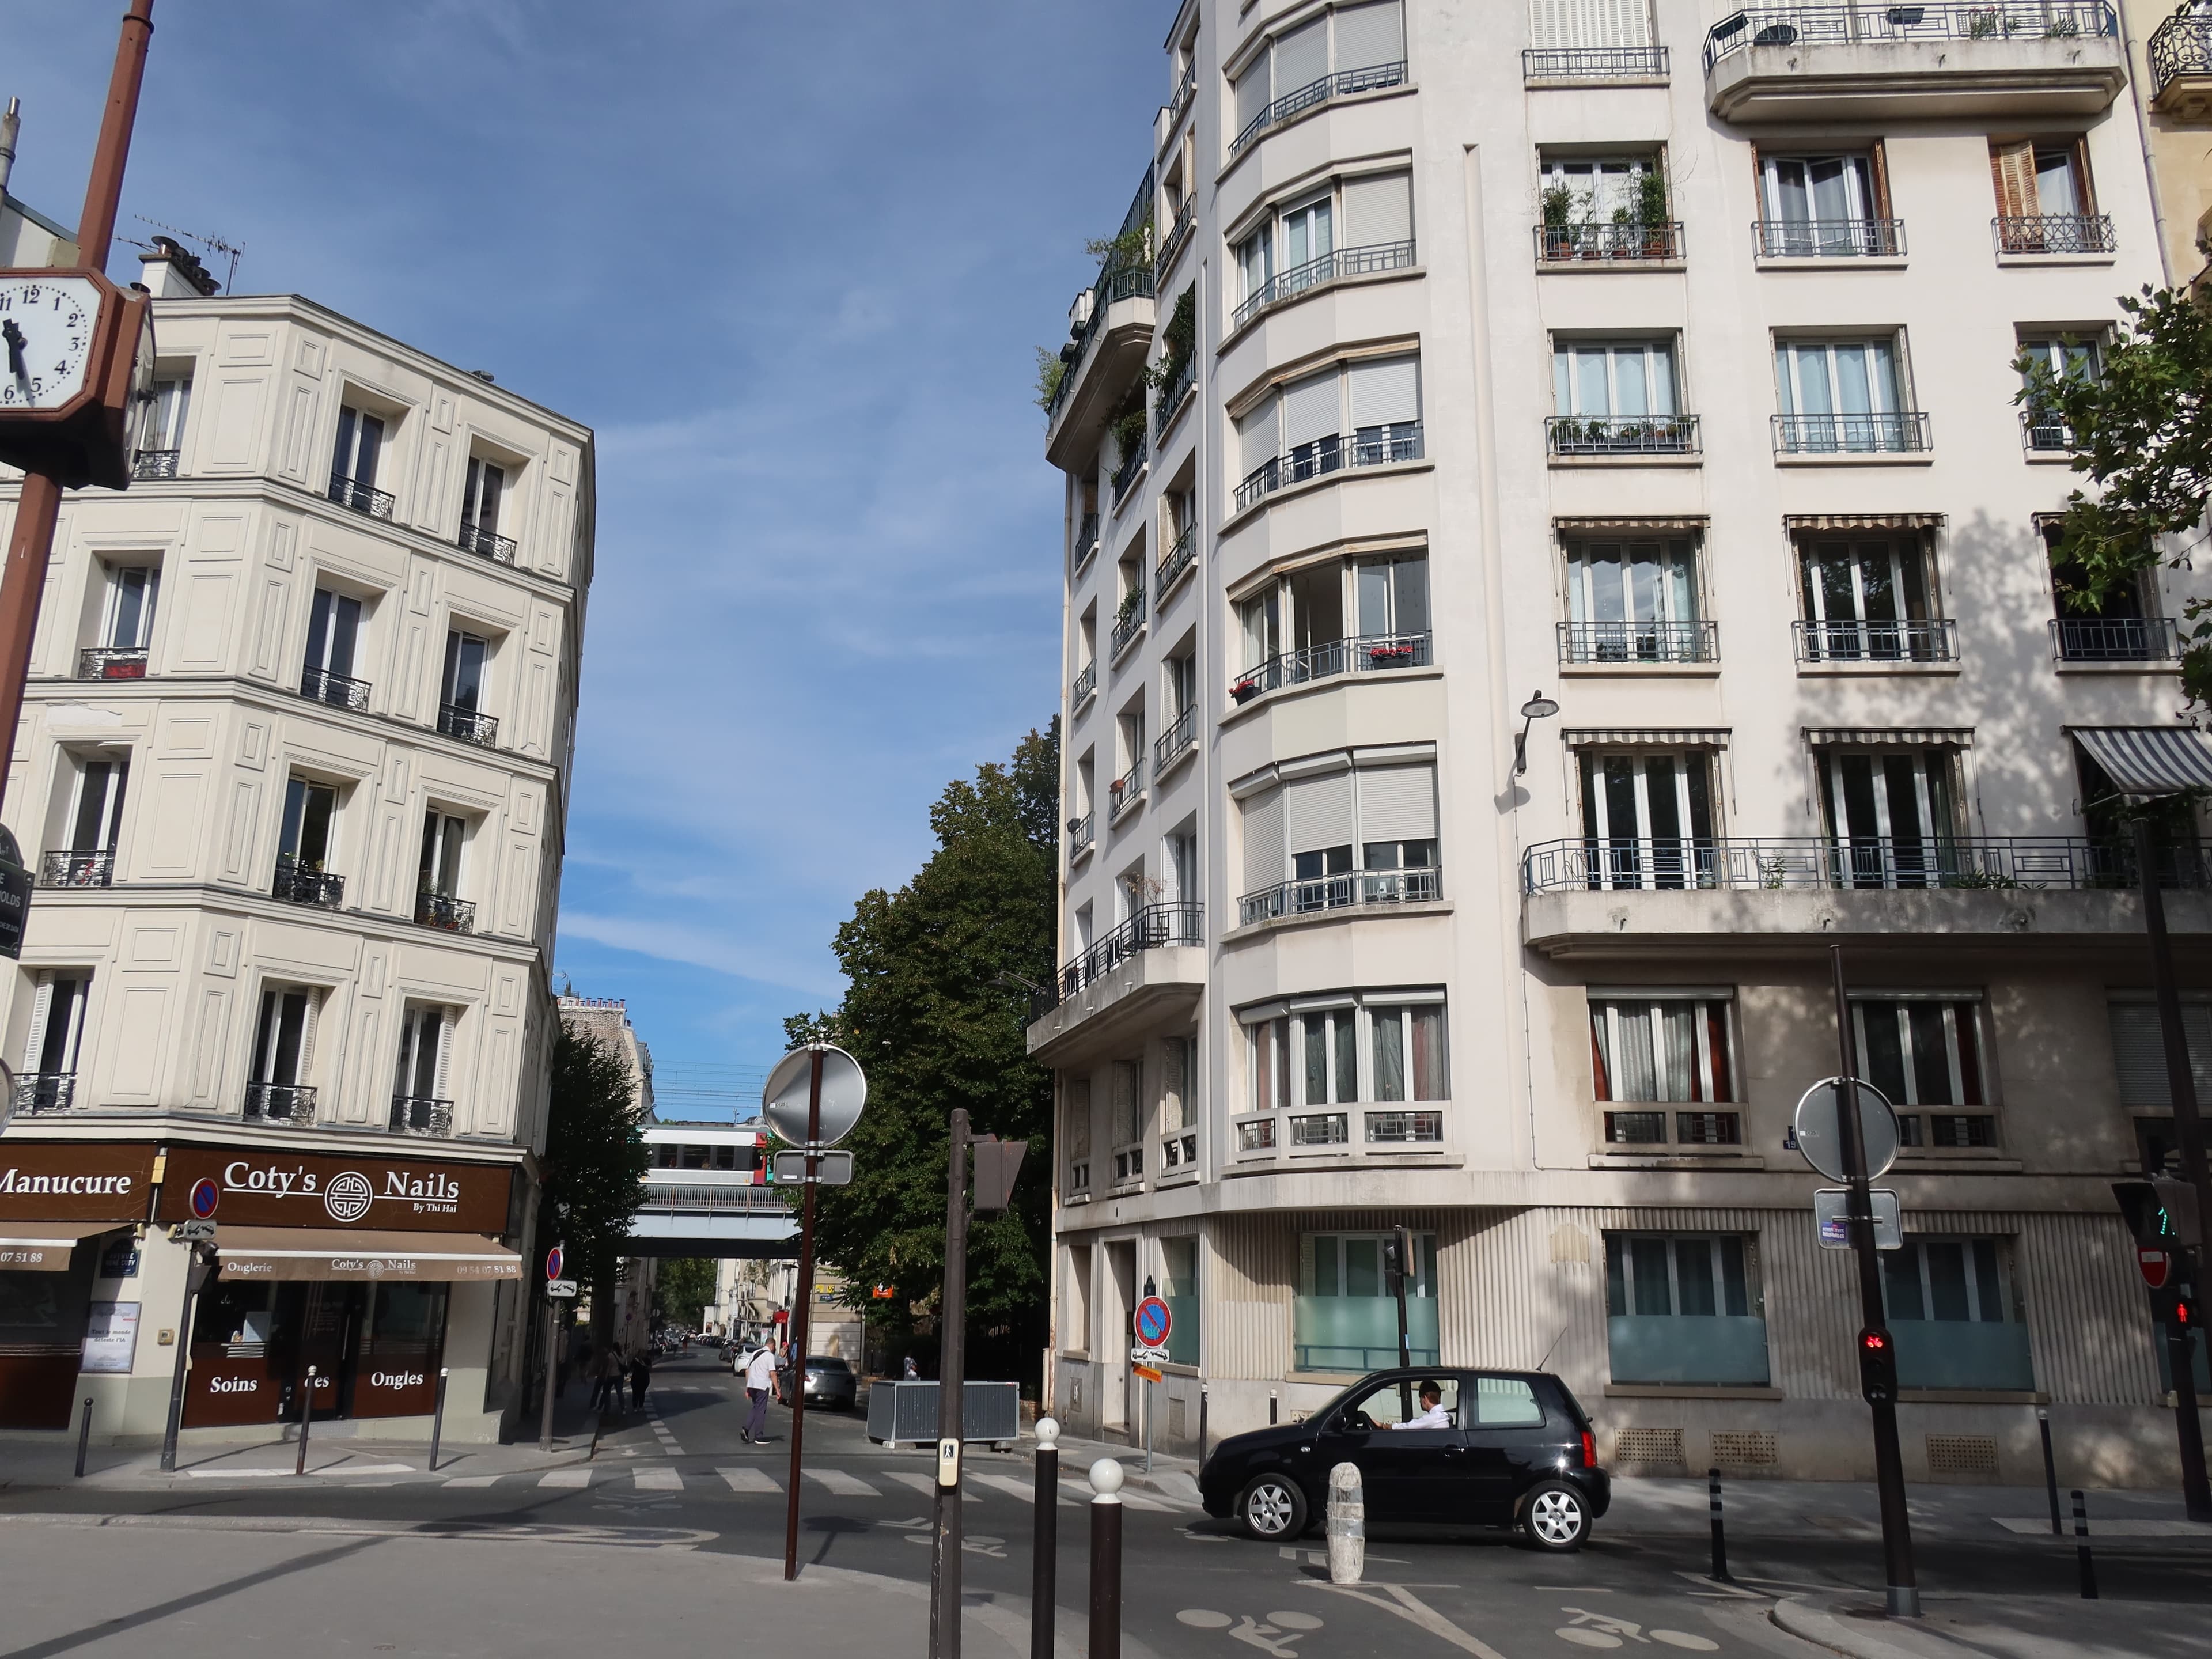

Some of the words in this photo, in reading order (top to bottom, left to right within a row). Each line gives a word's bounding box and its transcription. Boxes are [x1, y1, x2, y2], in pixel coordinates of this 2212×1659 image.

[22, 289, 40, 304] 12
[54, 297, 60, 311] 1
[66, 313, 78, 328] 2
[69, 337, 80, 351] 3
[54, 360, 67, 374] 4
[31, 377, 43, 392] 5
[4, 385, 14, 400] 6
[224, 1161, 317, 1198] Coty's
[384, 1171, 460, 1199] Nails
[413, 1203, 425, 1214] By
[426, 1203, 441, 1213] Thi
[442, 1205, 457, 1213] Hai
[0, 1252, 14, 1263] 07
[14, 1252, 28, 1263] 51
[30, 1252, 43, 1263] 88
[228, 1262, 272, 1274] Onglerie
[332, 1259, 364, 1271] Coty's
[388, 1260, 416, 1269] Nails
[457, 1266, 467, 1274] 09
[210, 1376, 258, 1393] Soins
[371, 1370, 423, 1391] Ongles
